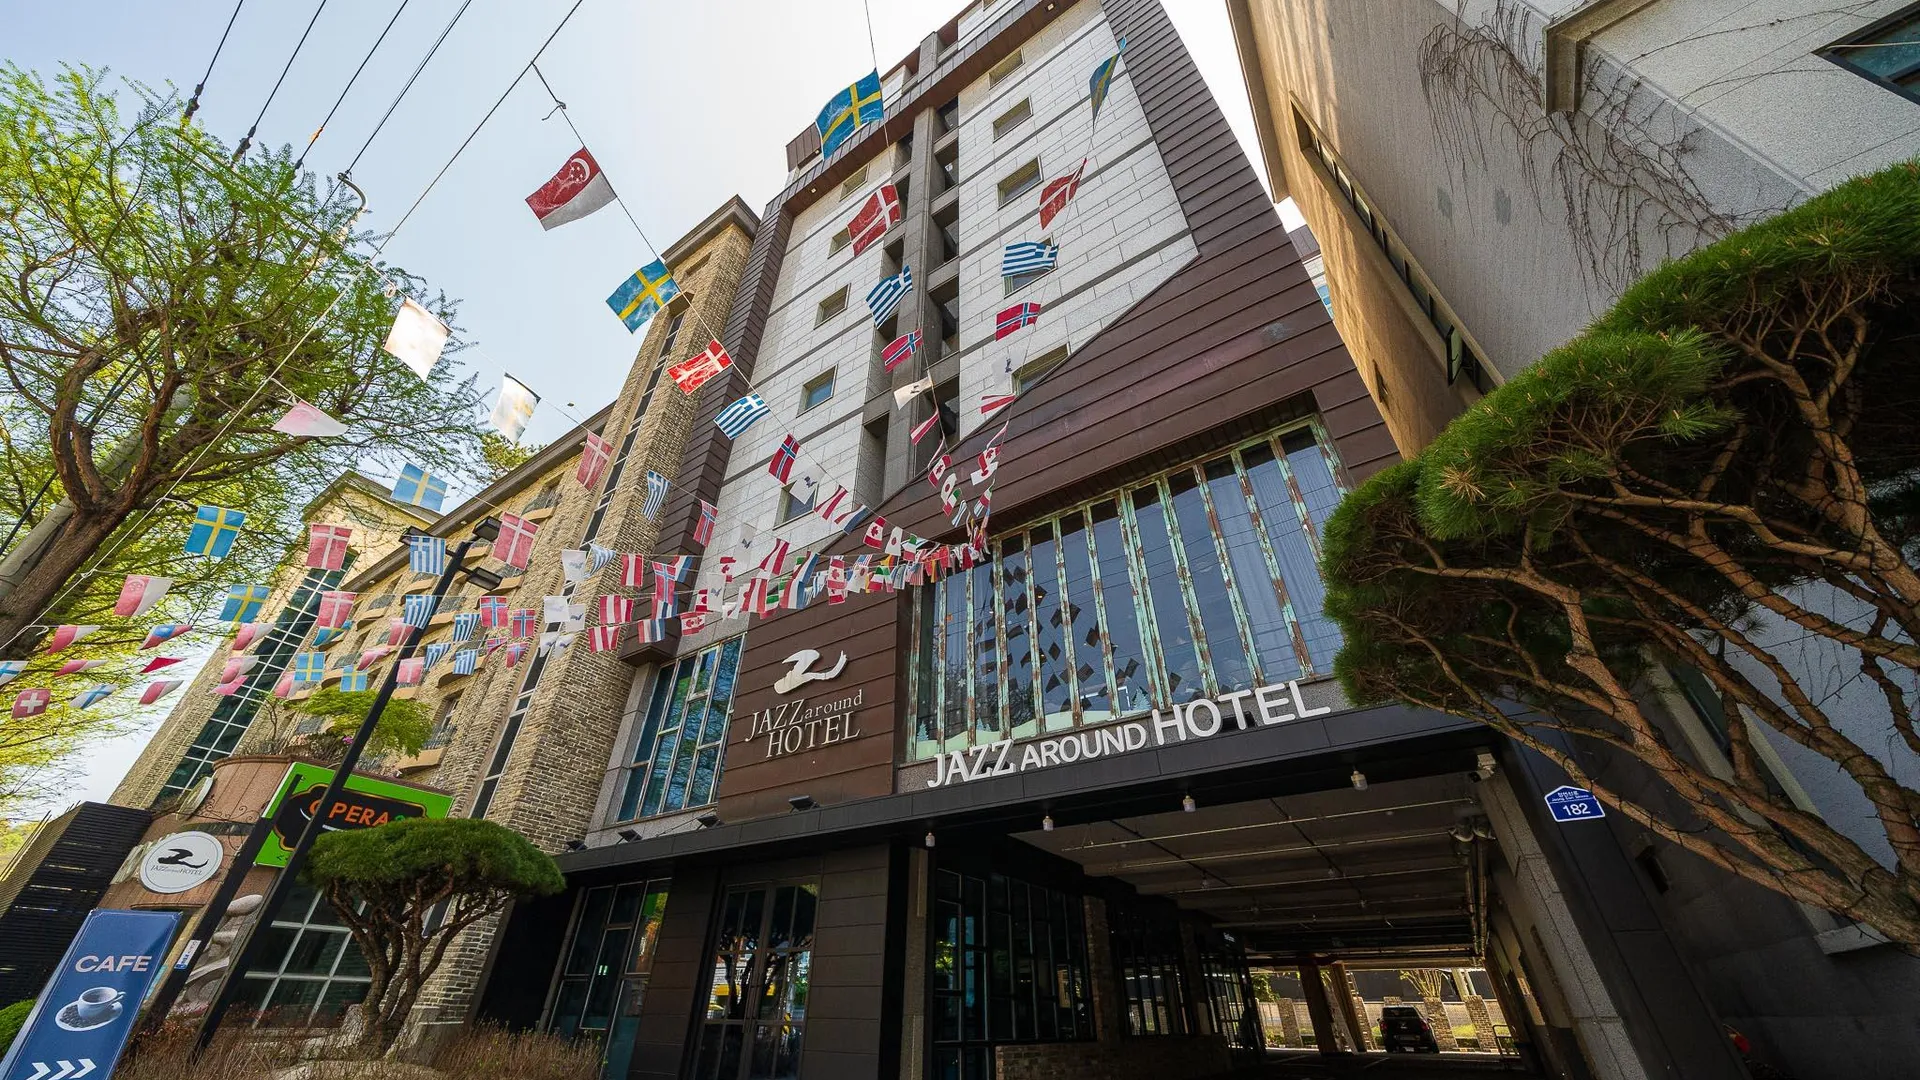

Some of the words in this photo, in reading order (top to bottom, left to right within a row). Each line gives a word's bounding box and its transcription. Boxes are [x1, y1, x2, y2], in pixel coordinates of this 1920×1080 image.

[765, 711, 861, 758] HOTEL
[926, 738, 1016, 788] JAZZ
[1020, 722, 1147, 771] AROUND
[1151, 679, 1331, 745] HOTEL
[1562, 802, 1591, 816] 182
[75, 955, 153, 973] CAFE
